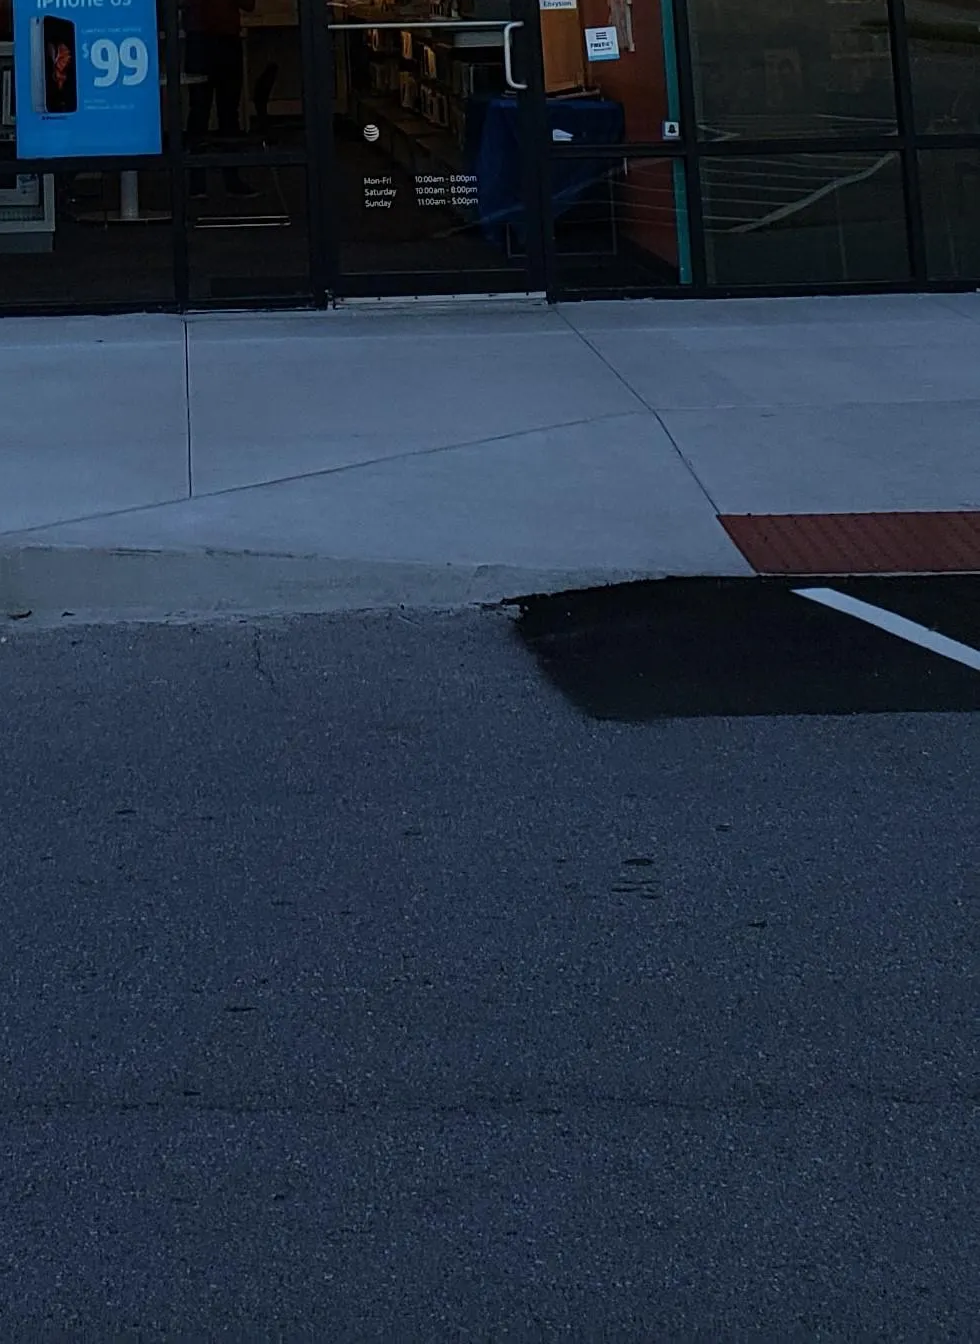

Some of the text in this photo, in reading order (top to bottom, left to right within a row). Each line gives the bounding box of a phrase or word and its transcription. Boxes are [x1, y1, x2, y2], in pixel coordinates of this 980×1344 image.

[82, 37, 149, 88] $99
[363, 176, 392, 185] Mon-Fri
[364, 188, 396, 197] Saturday
[365, 199, 392, 208] Sunday
